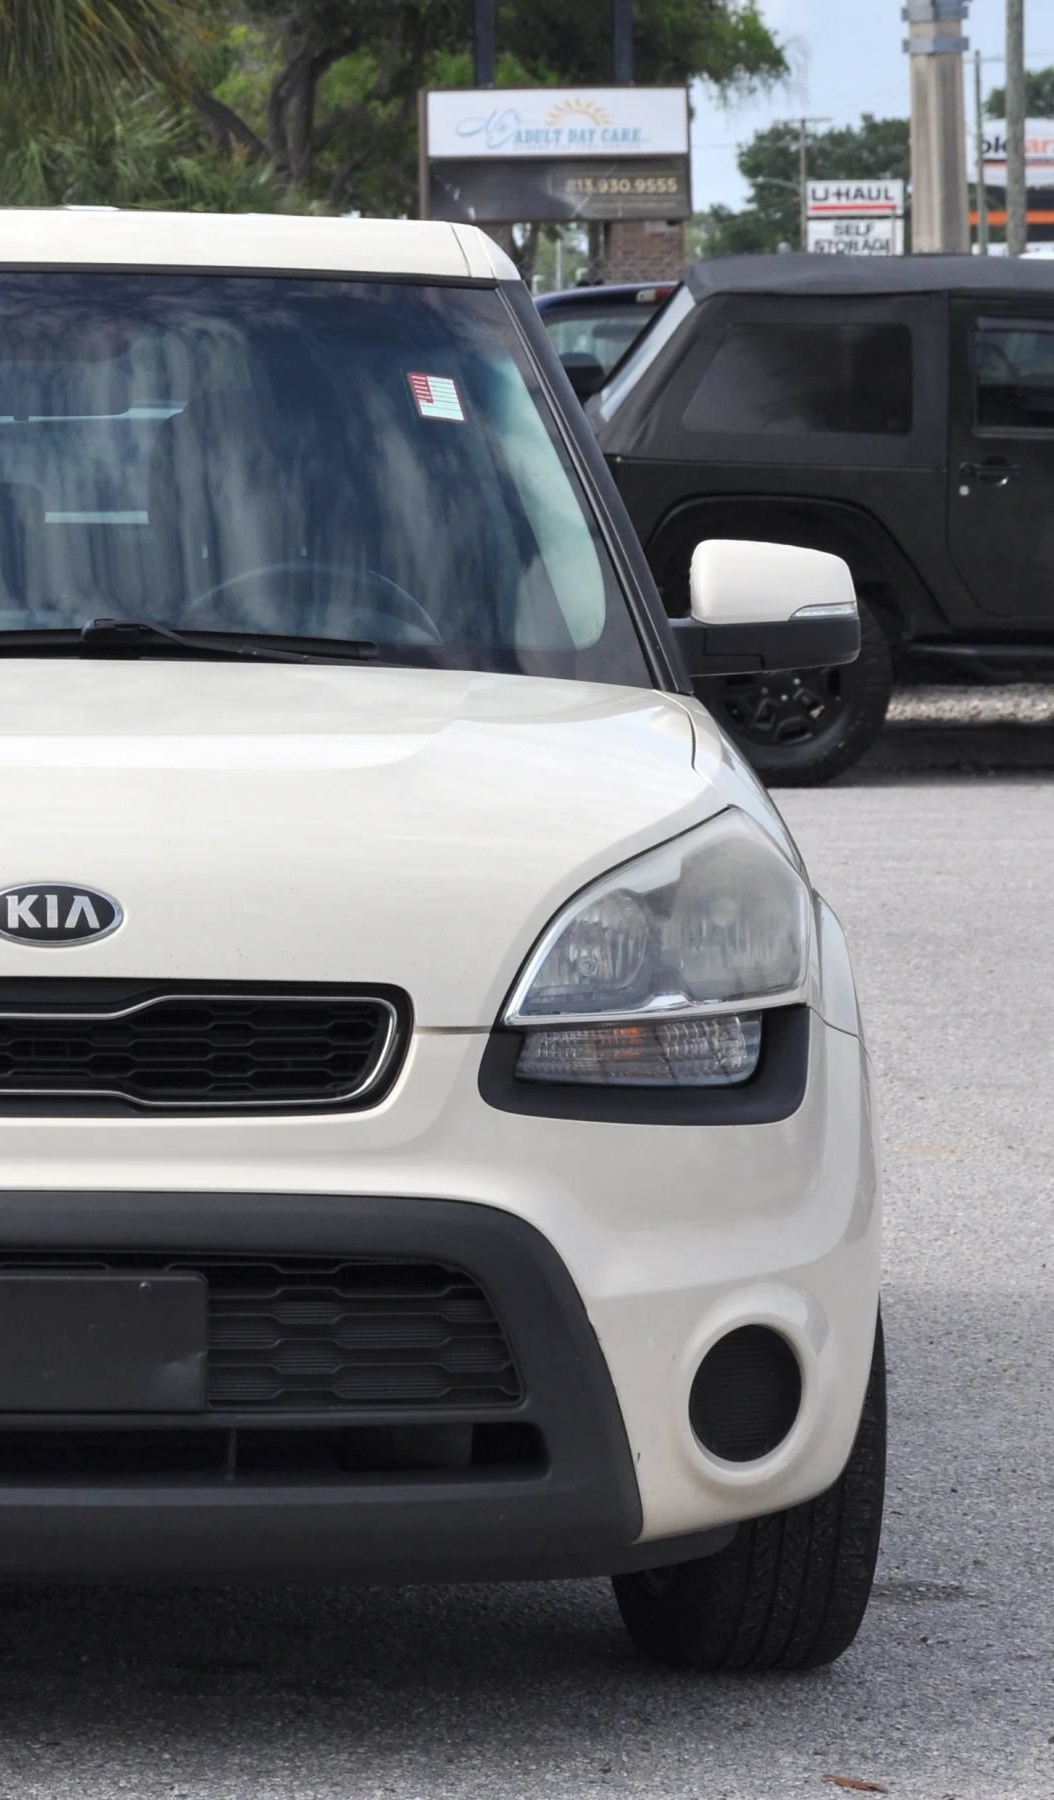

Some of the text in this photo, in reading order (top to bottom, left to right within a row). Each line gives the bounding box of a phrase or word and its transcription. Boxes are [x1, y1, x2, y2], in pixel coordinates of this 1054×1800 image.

[513, 127, 643, 144] ADULT DAY CARE
[811, 186, 895, 201] U-HAUL
[833, 222, 874, 236] SELF
[5, 894, 101, 929] KIA
